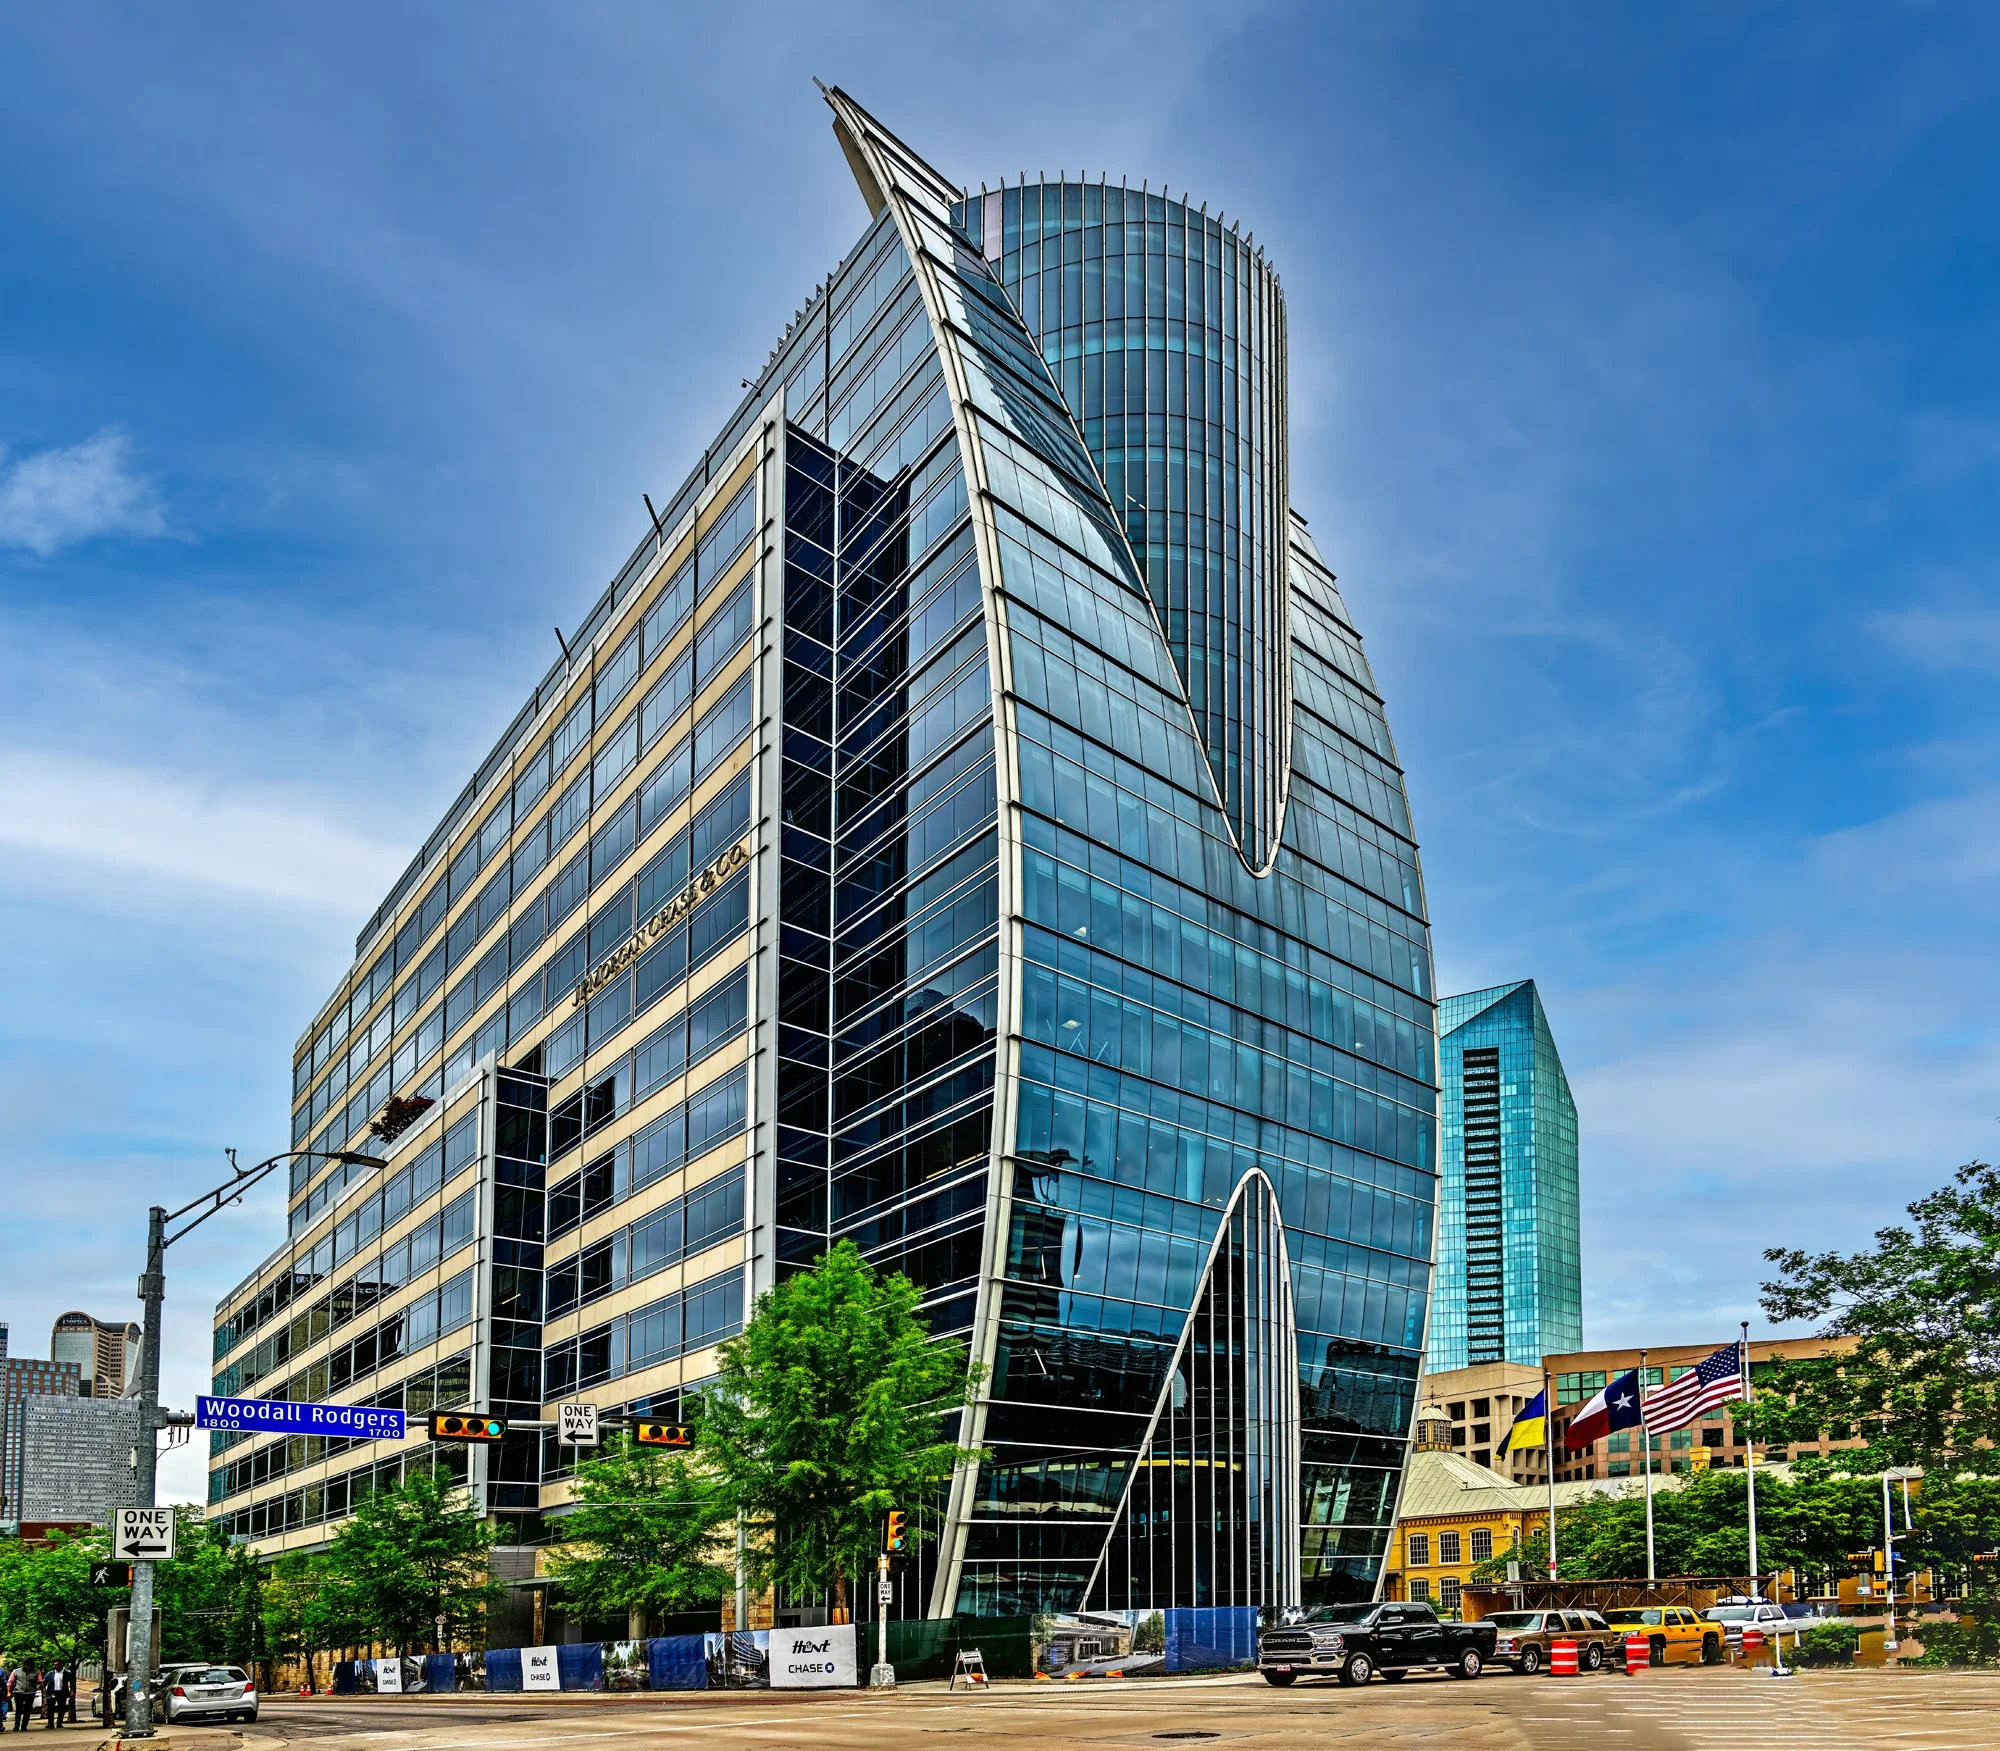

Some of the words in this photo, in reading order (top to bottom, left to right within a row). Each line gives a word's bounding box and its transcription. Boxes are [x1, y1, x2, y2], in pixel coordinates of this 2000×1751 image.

[649, 884, 698, 936] CHASE
[700, 869, 715, 892] &
[206, 1400, 301, 1421] Woodall
[312, 1408, 398, 1428] Rodgers
[564, 1406, 592, 1417] ONE
[203, 1418, 240, 1428] 1800
[565, 1418, 594, 1429] WAY
[369, 1428, 400, 1438] 1700
[124, 1510, 166, 1524] ONE
[124, 1525, 169, 1539] WAY
[788, 1663, 823, 1674] CHASE
[530, 1673, 546, 1681] CHASE
